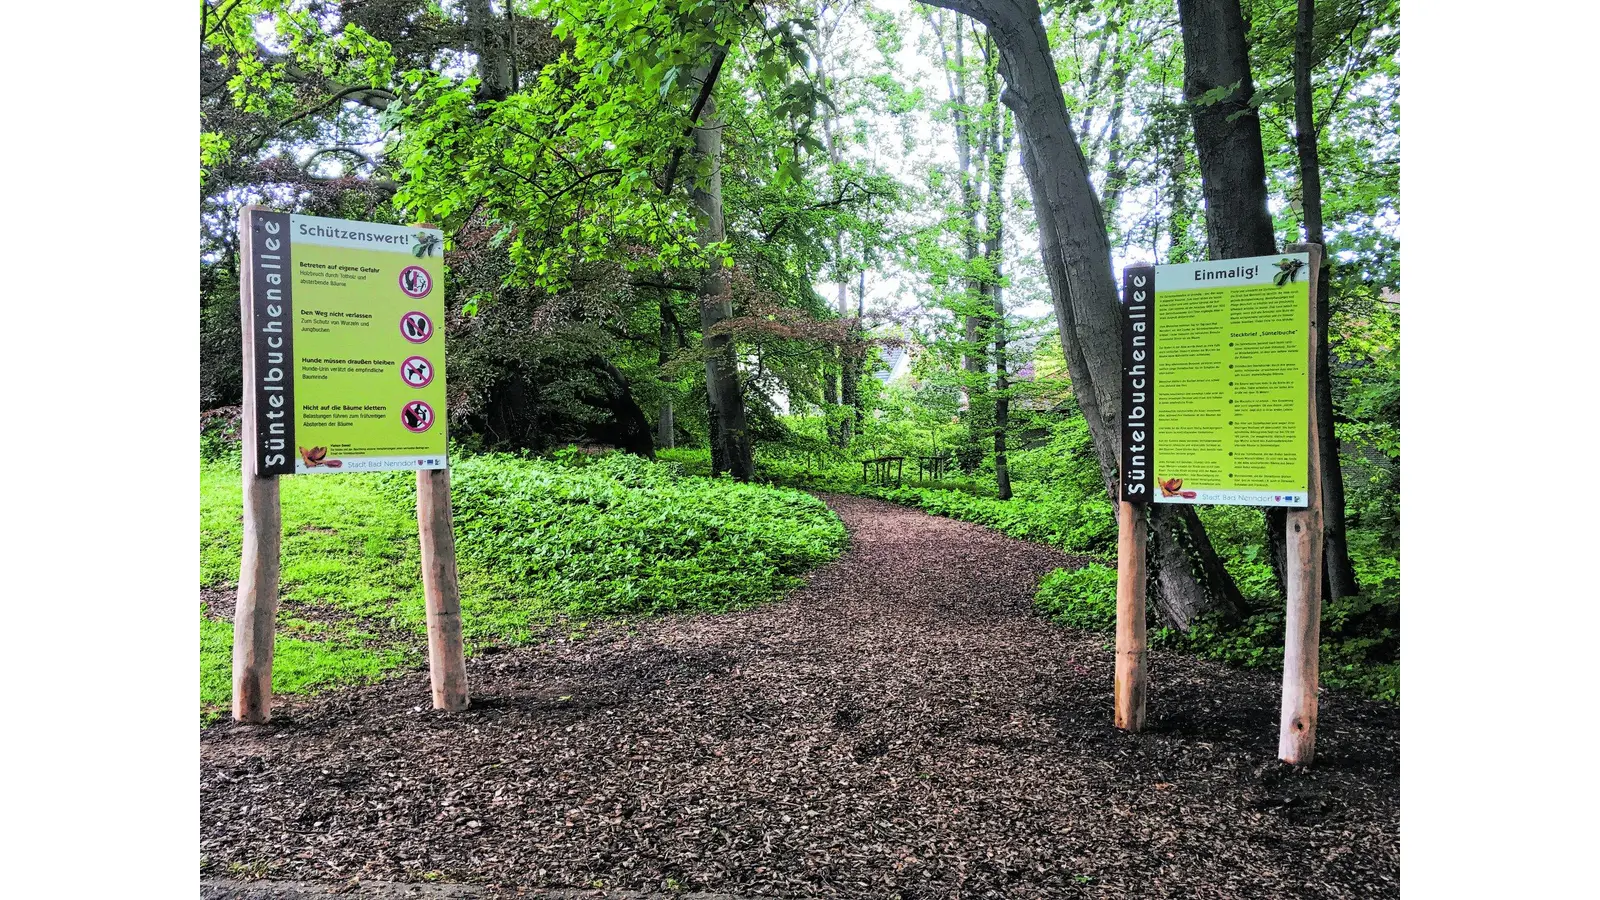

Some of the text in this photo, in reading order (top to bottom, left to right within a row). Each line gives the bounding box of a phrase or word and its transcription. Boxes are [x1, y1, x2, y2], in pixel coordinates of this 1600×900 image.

[300, 224, 408, 244] Schützenswert!
[1194, 266, 1258, 281] Einmalig!
[260, 220, 285, 468] Süntelbuchenallee
[1128, 275, 1146, 494] Süntelbuchenallee
[1239, 494, 1273, 502] Nenndorf
